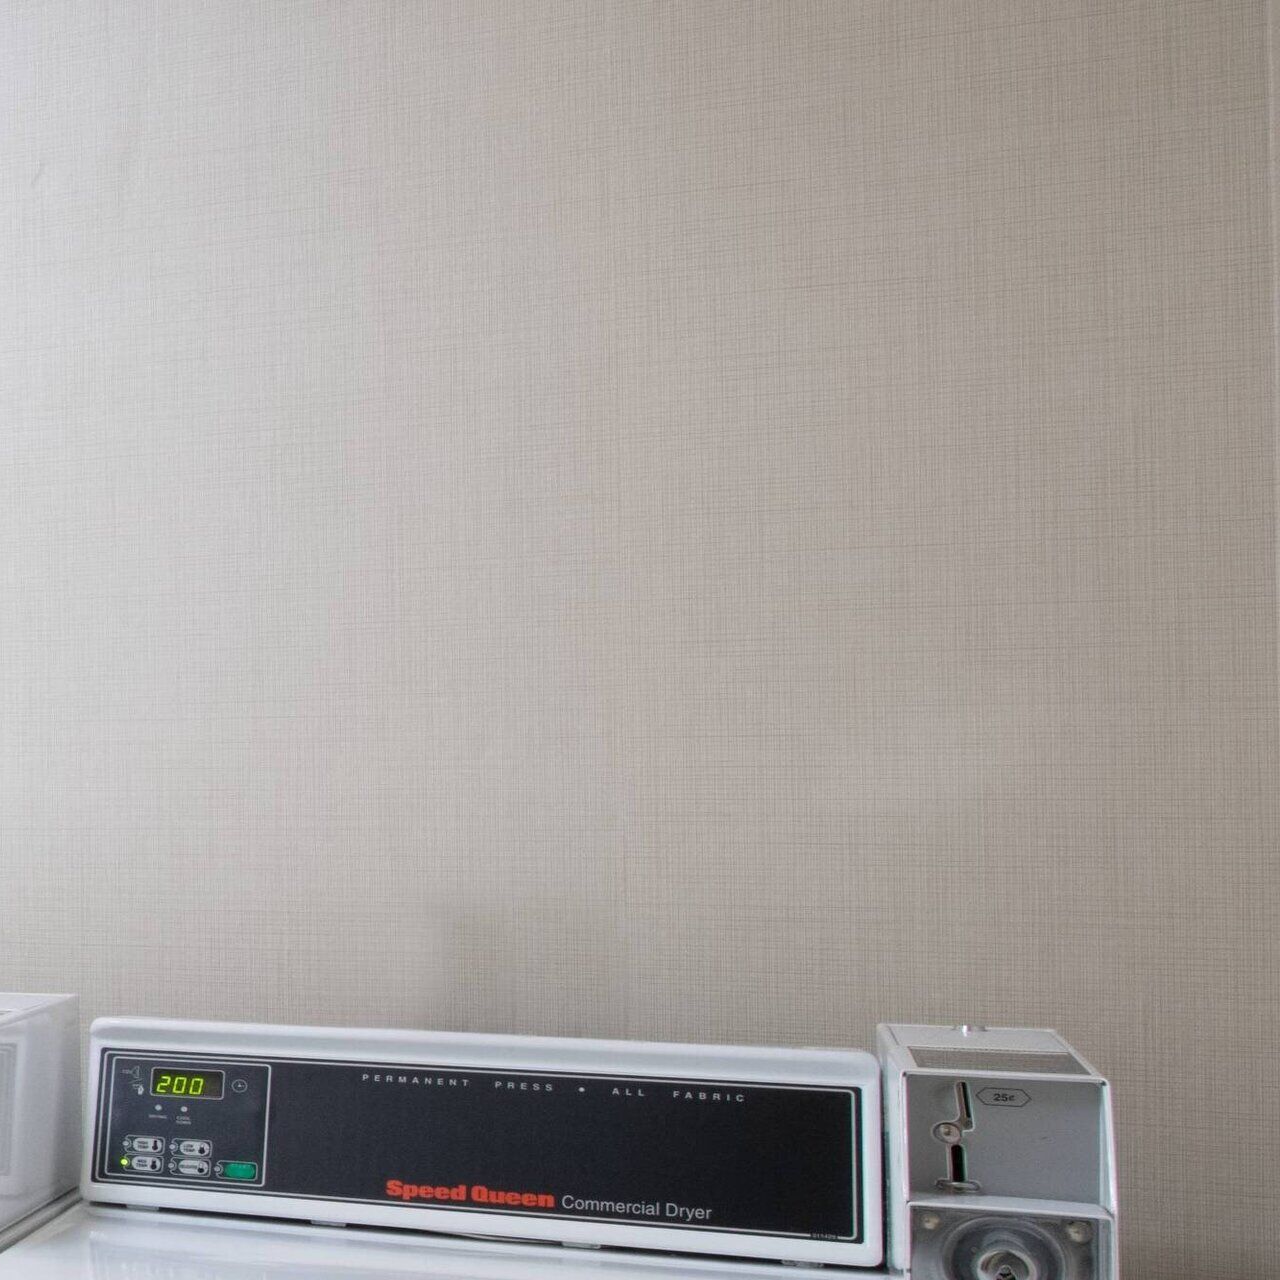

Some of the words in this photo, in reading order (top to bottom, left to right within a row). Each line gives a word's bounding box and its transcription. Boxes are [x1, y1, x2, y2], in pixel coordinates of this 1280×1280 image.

[155, 1075, 204, 1095] 200
[361, 1073, 471, 1087] PERMANENT
[494, 1080, 554, 1093] PRESS
[611, 1087, 646, 1098] ALL
[671, 1090, 746, 1103] FABRIC
[385, 1179, 467, 1201] Speed
[470, 1185, 555, 1208] Queen
[561, 1195, 660, 1216] Commercial
[666, 1202, 713, 1221] Dryer
